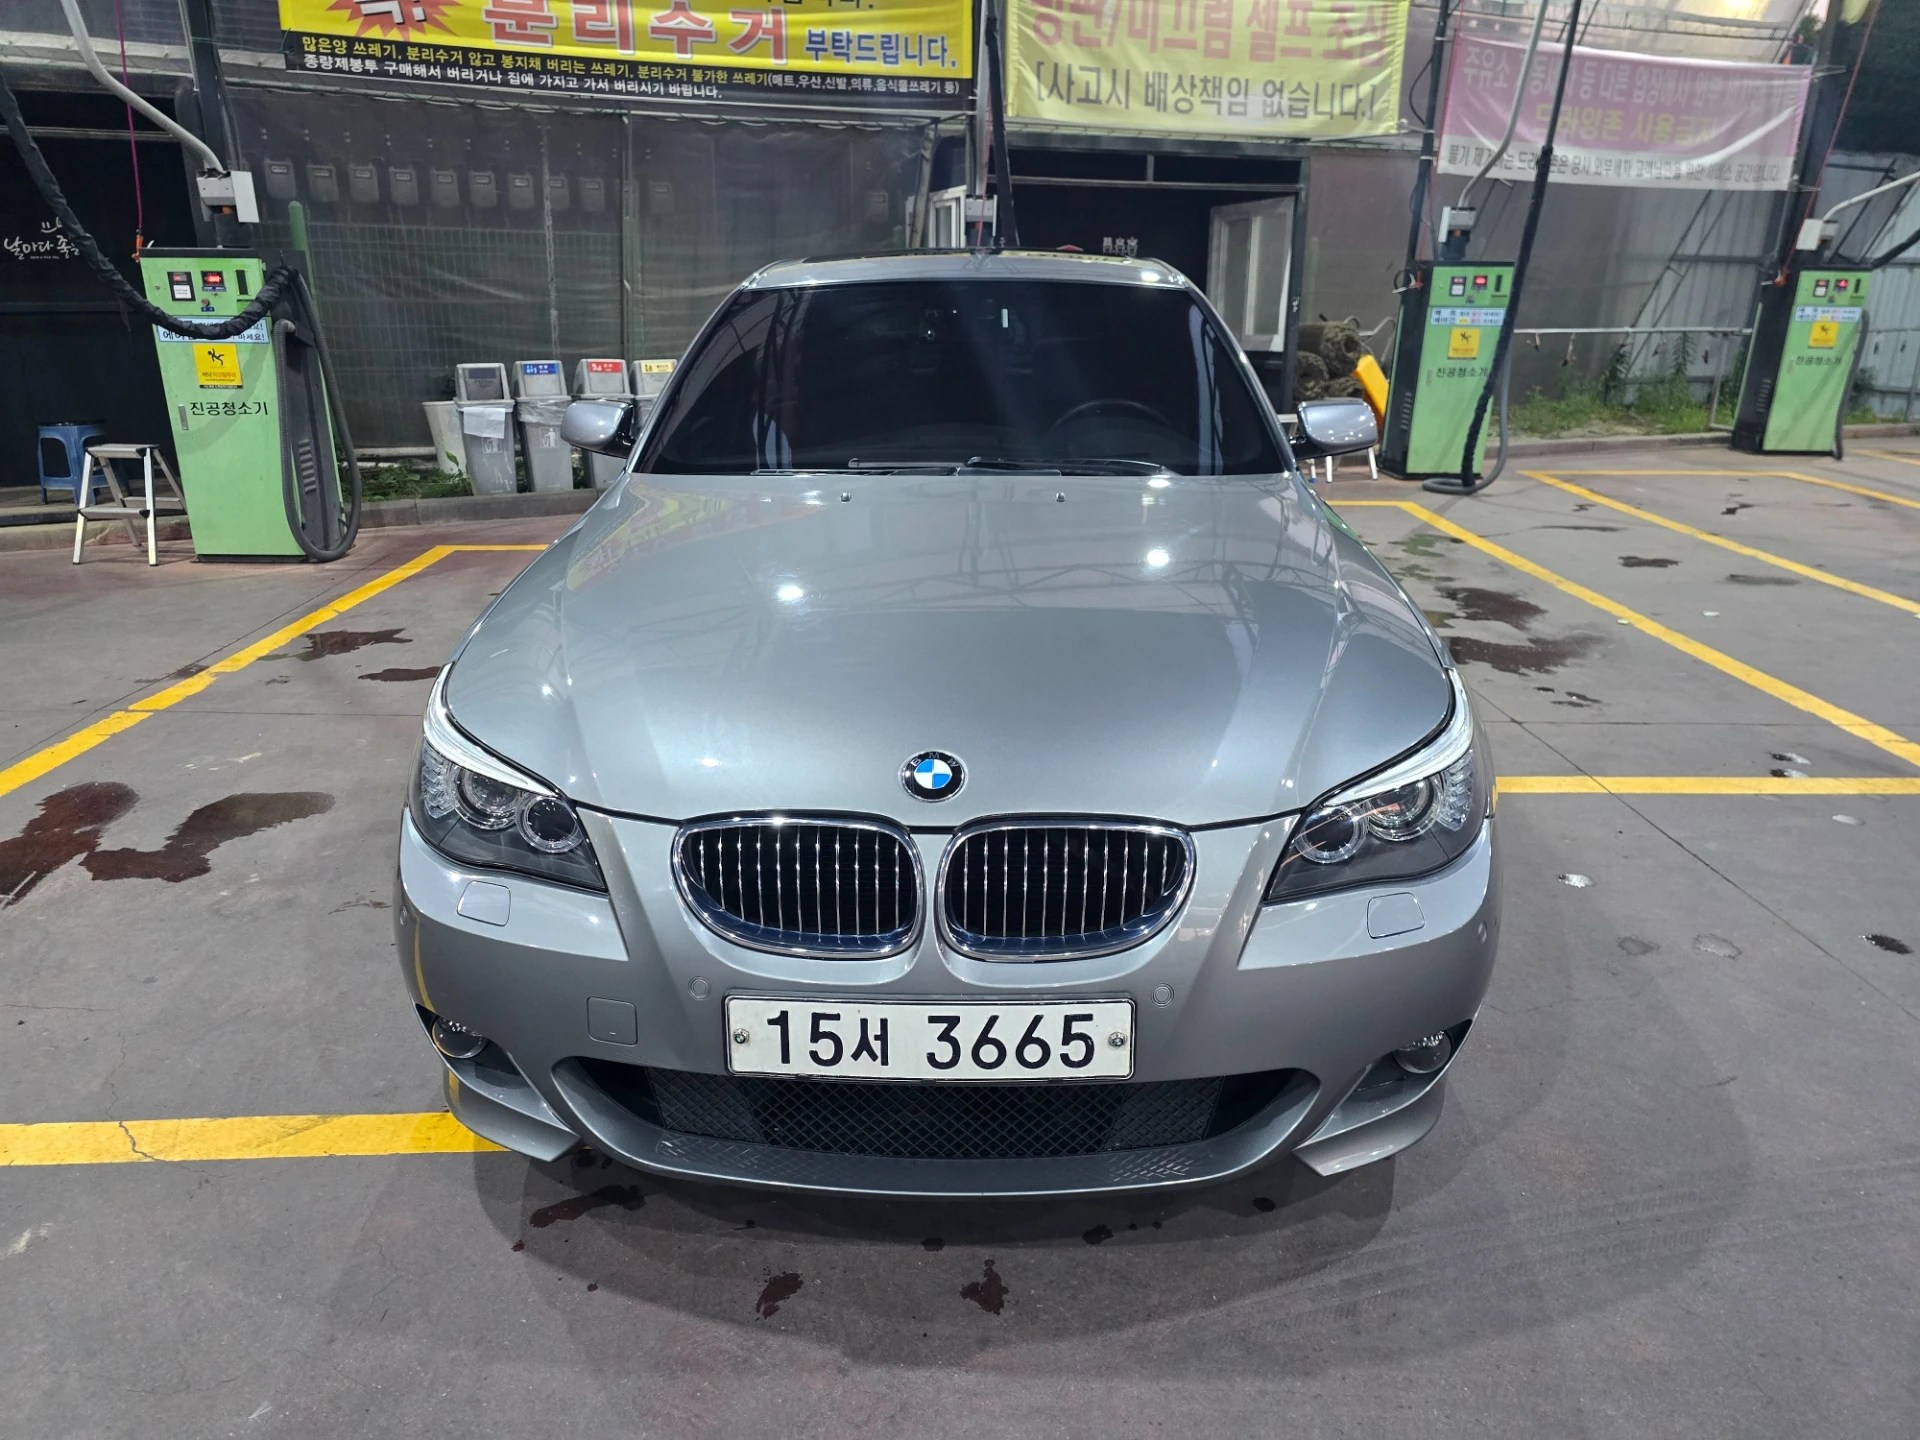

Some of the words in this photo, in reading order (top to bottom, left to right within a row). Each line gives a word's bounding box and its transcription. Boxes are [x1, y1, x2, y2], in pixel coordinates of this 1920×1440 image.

[483, 0, 788, 64] 분리수거
[804, 29, 958, 69] 부탁드립니다.
[302, 36, 348, 55] 많은양
[406, 46, 463, 65] 분리수거
[468, 52, 497, 67] 않고
[501, 54, 542, 71] 봉지채
[546, 59, 586, 75] 버리는
[637, 65, 688, 82] 분리수거
[691, 69, 729, 84] 불가한
[303, 53, 379, 74] 종량제봉투
[383, 61, 442, 80] 구매해서
[446, 67, 502, 84] 버리거나
[507, 72, 535, 87] 집에
[539, 75, 579, 90] 가지고
[583, 78, 610, 92] 가서
[613, 80, 665, 96] 버리시기
[668, 84, 723, 99] 바랍니다.
[1463, 46, 1510, 89] 주유소
[1143, 70, 1249, 117] 배상책임
[3, 235, 55, 261] 날마다
[189, 401, 268, 416] 진공청소기
[766, 1009, 890, 1069] 15서
[925, 1013, 1096, 1070] 3665
